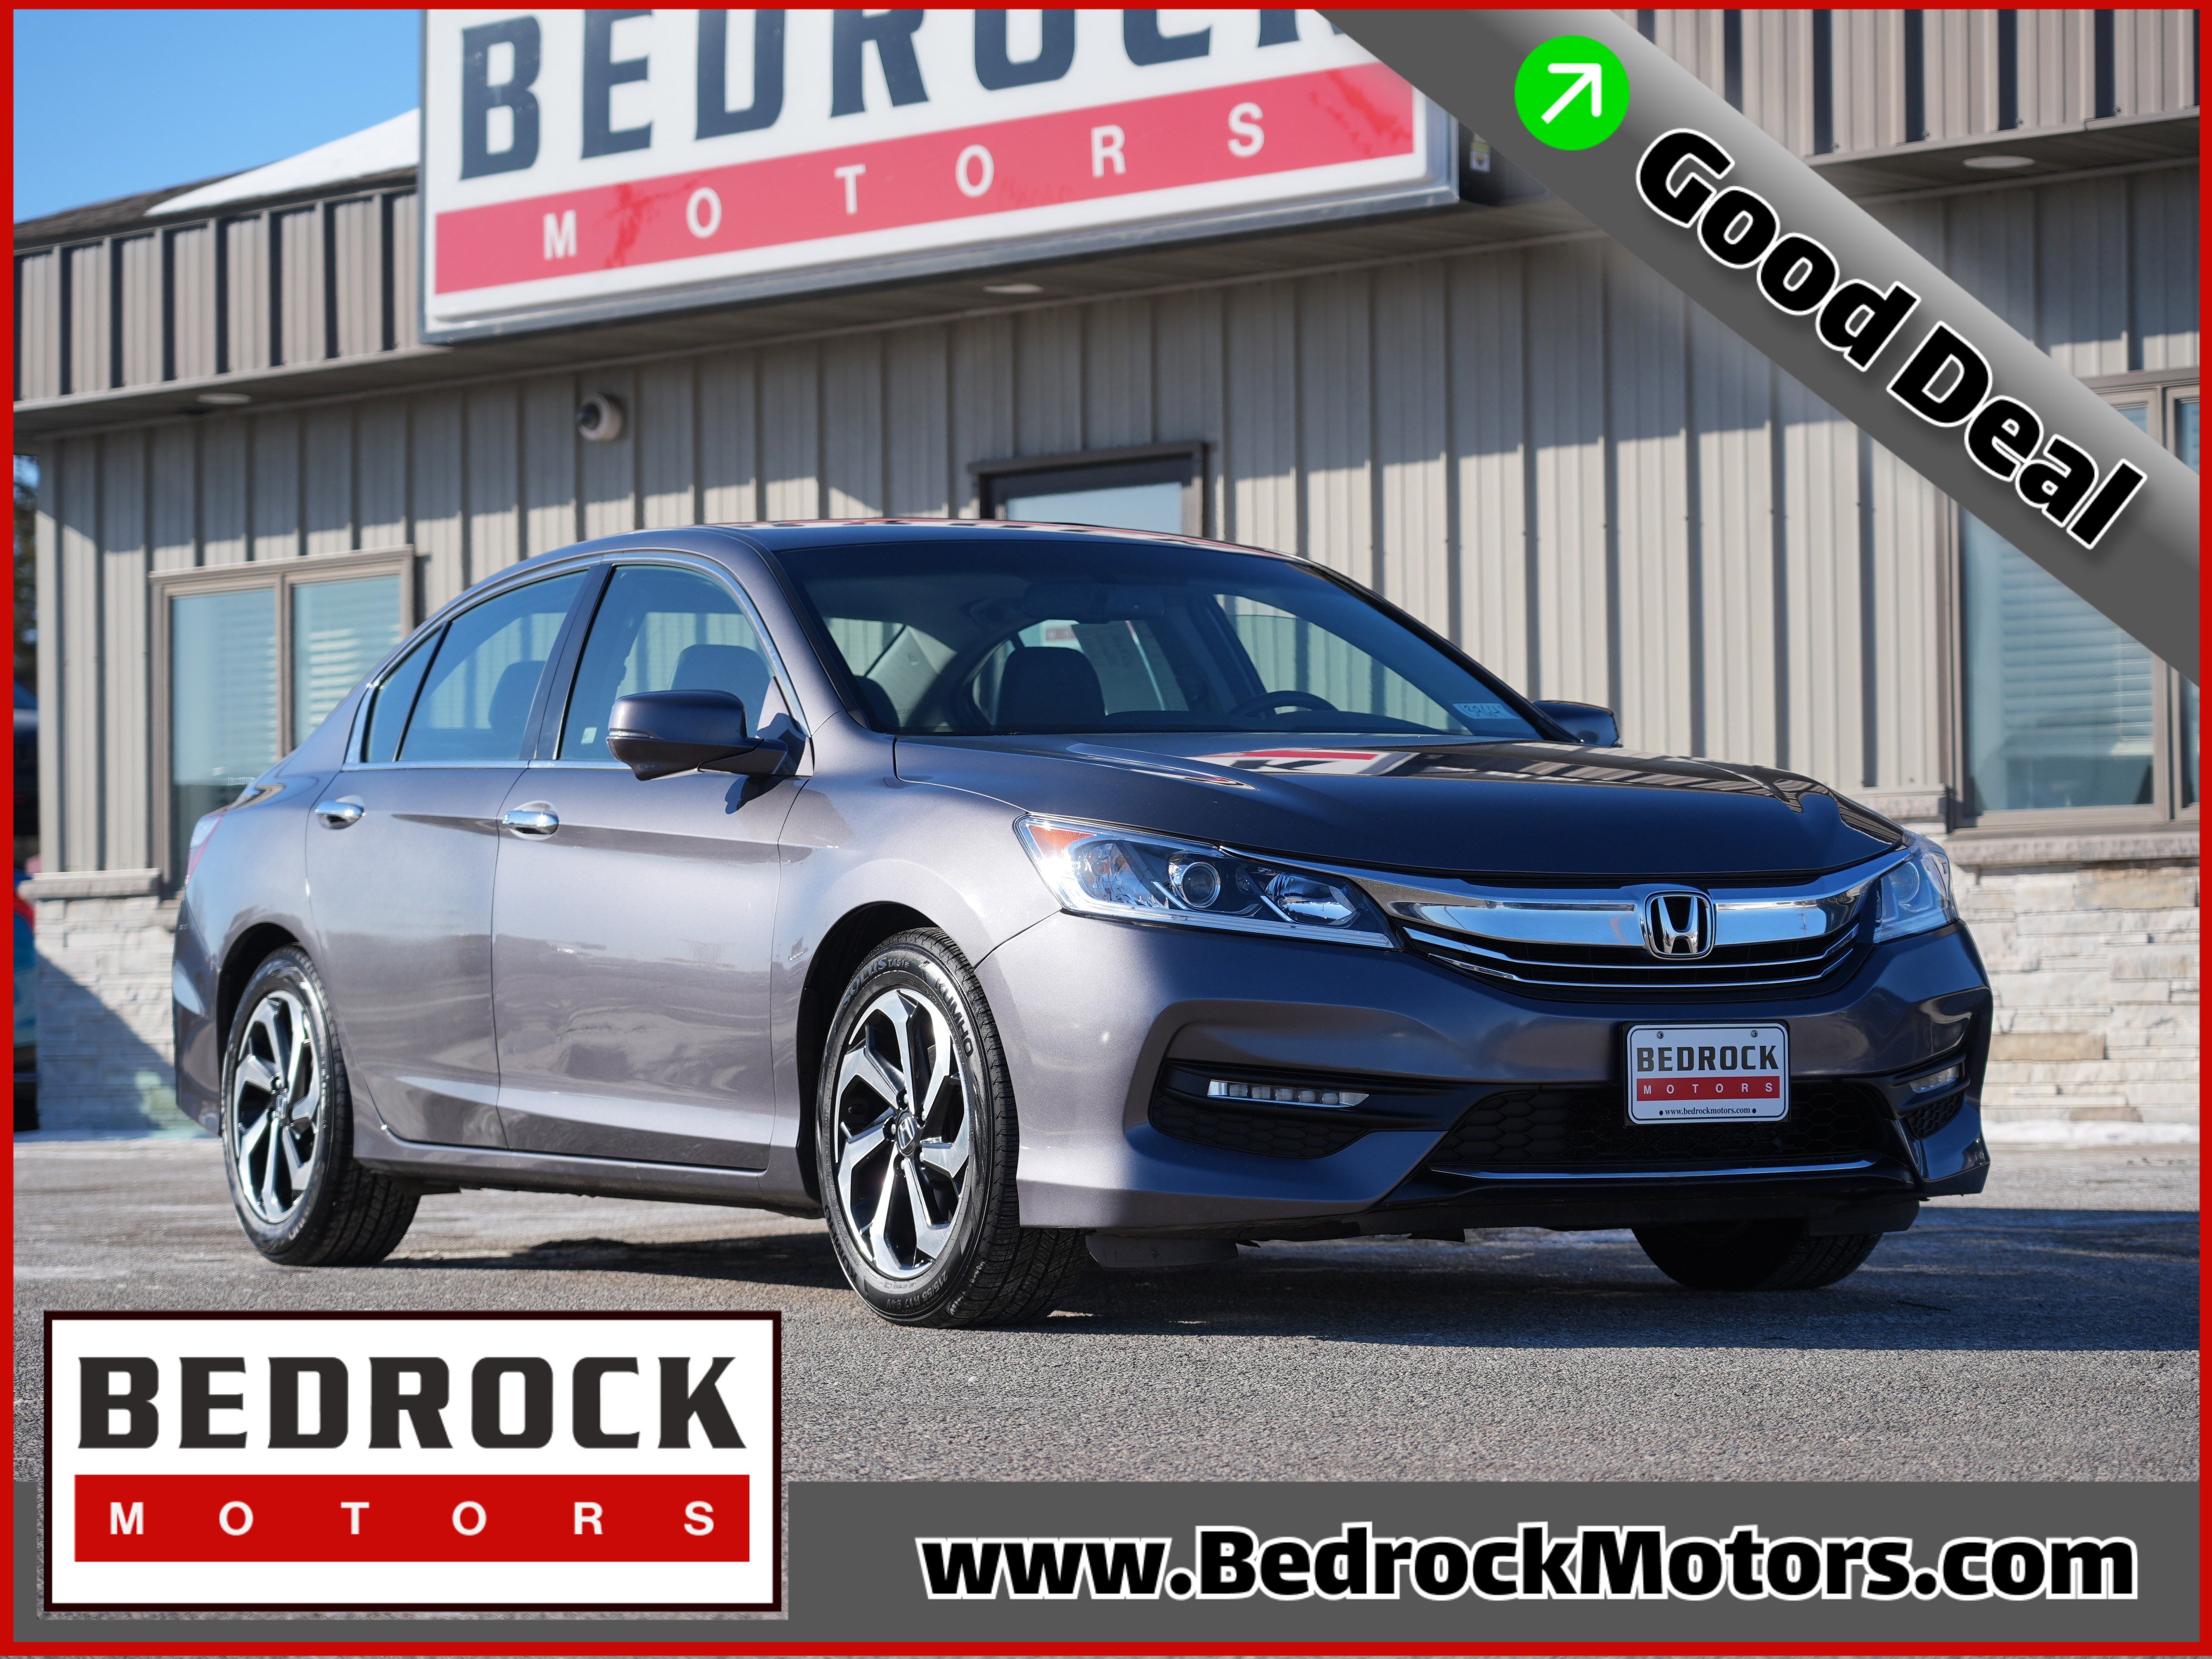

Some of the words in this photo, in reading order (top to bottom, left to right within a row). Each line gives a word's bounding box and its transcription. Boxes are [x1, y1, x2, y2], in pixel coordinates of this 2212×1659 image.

[459, 9, 1346, 181] BEDRO
[543, 103, 1265, 260] MOTORS
[934, 977, 974, 1057] KUMHO
[1637, 1046, 1779, 1072] BEDROCK
[1643, 1082, 1773, 1095] MOTORS
[1665, 1107, 1751, 1116] www.bedrockmotors.com
[921, 1270, 948, 1301] 215/55
